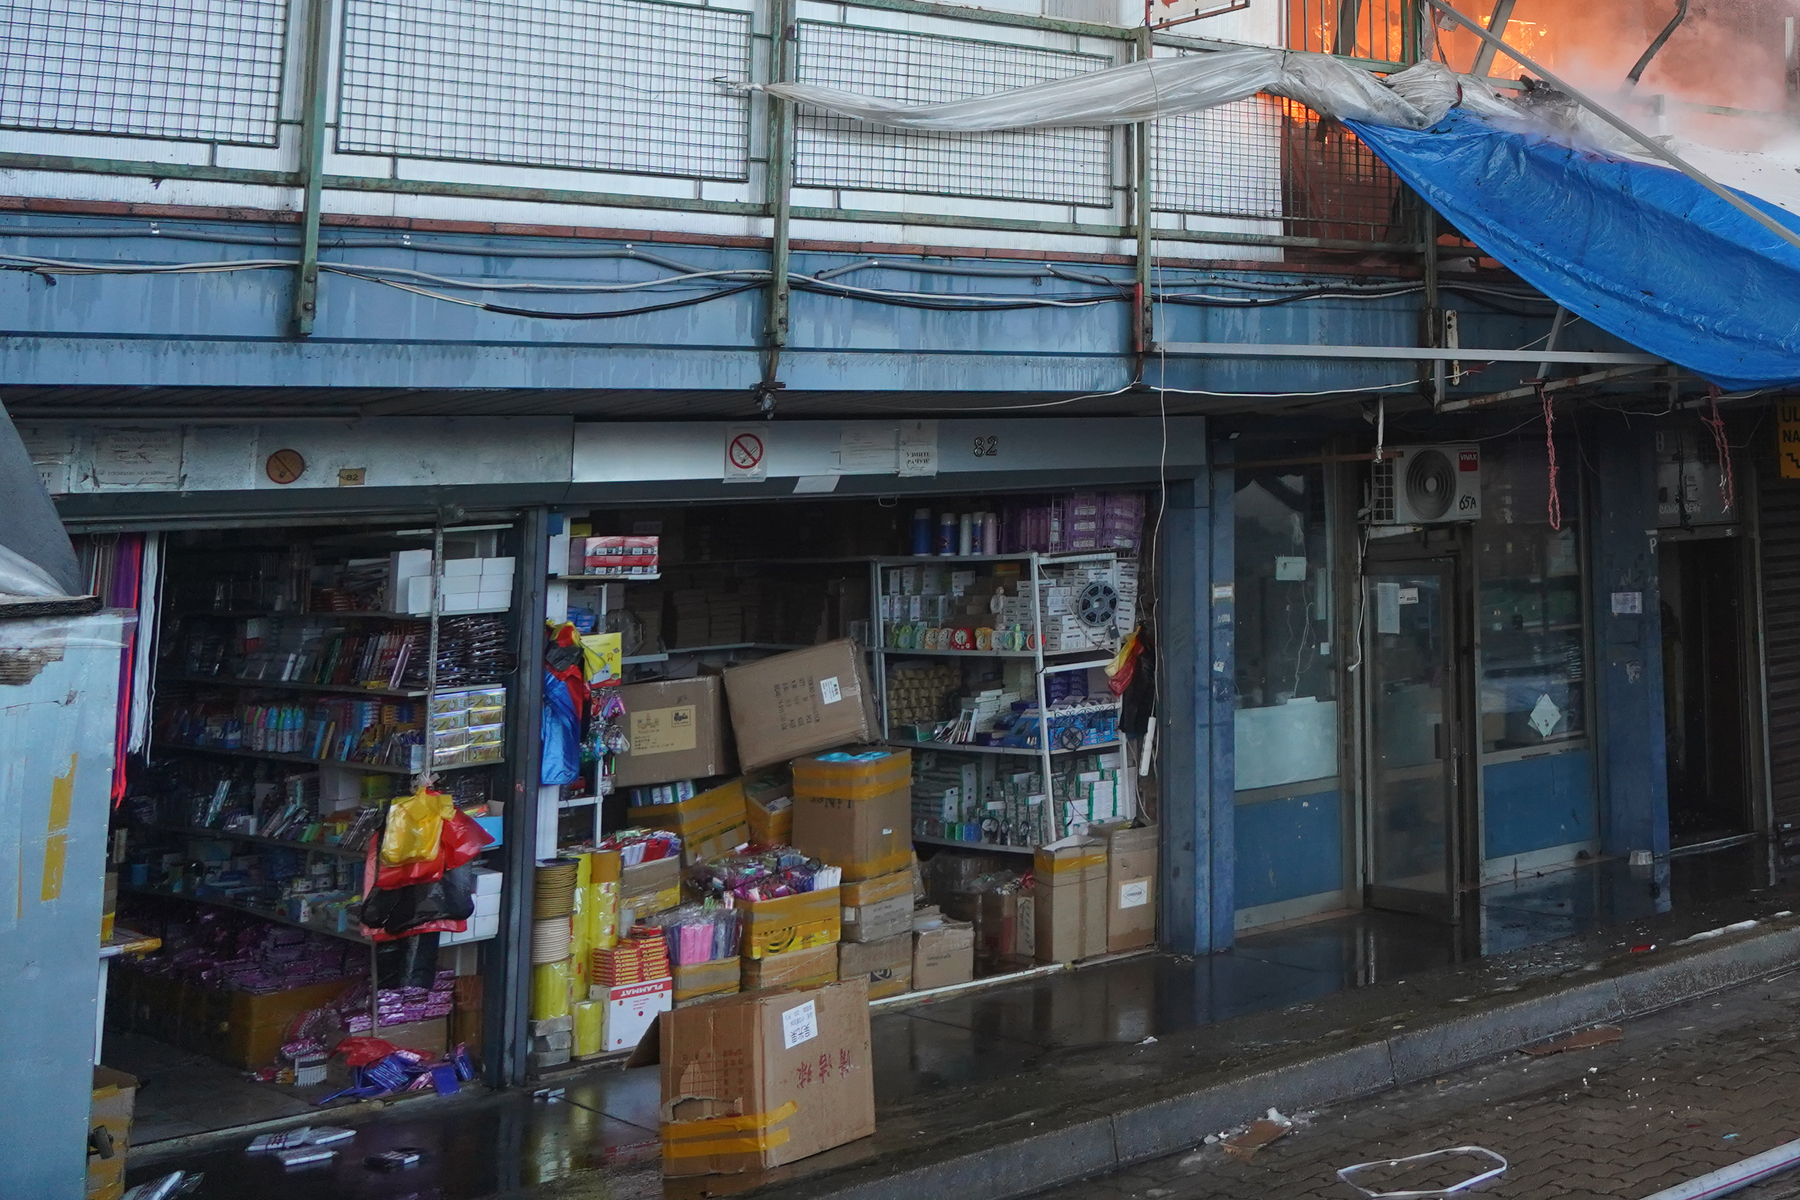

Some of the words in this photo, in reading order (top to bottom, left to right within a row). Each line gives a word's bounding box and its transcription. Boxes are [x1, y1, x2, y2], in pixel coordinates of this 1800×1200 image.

[1783, 429, 1800, 443] NA
[973, 435, 998, 457] 82
[1459, 494, 1477, 511] 65A
[620, 983, 664, 997] FLAMMAT
